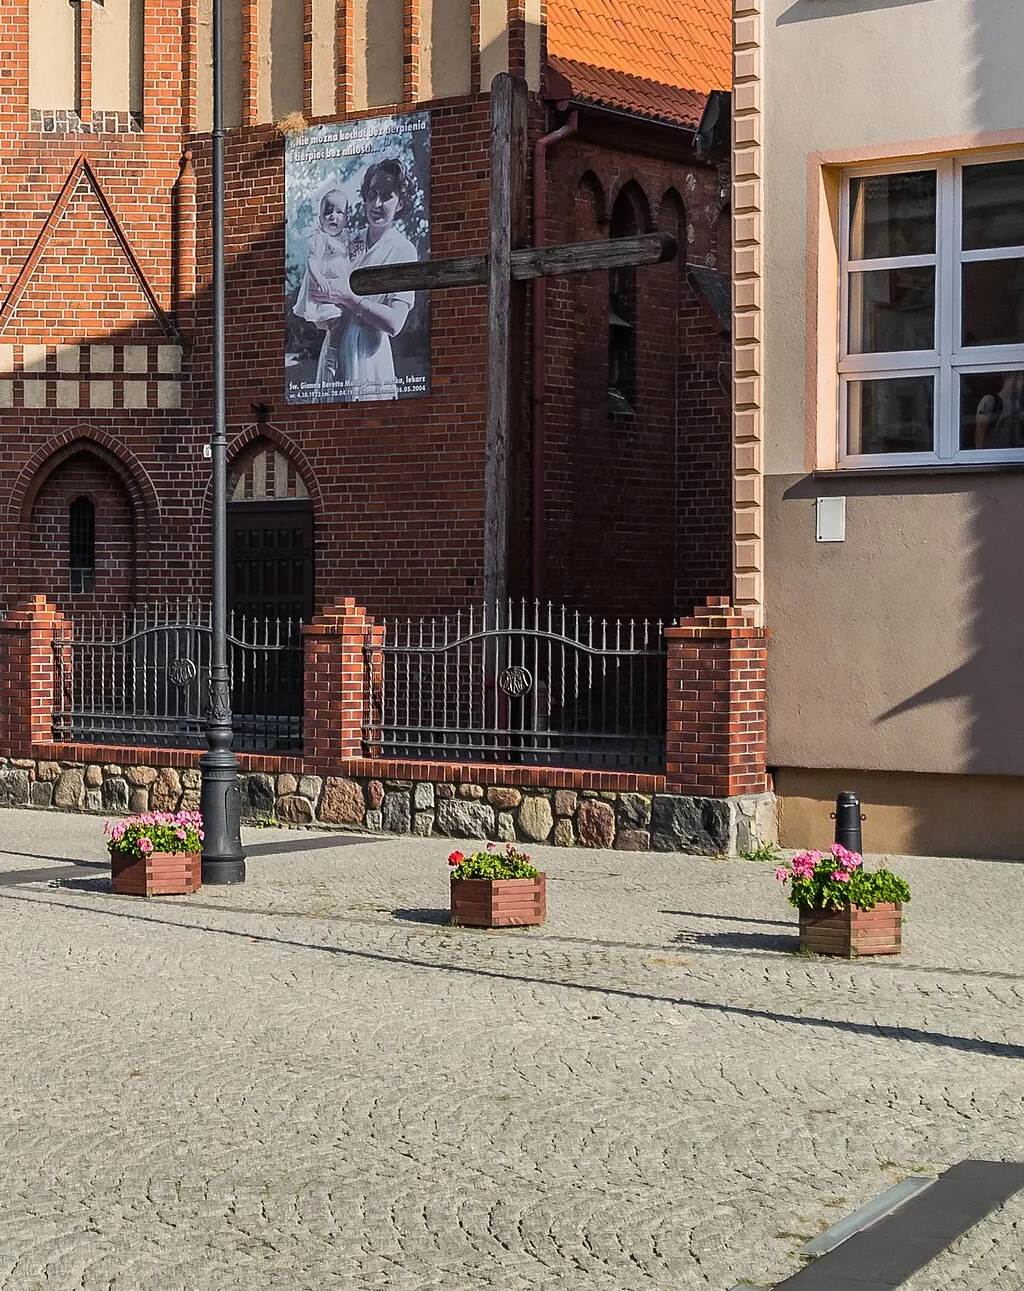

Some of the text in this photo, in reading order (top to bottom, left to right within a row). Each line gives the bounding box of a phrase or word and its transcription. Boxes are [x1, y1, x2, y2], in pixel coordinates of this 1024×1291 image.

[310, 132, 338, 145] można
[339, 127, 367, 141] kochać
[368, 125, 384, 138] bez
[385, 120, 426, 136] cierpienia
[290, 149, 294, 163] i
[295, 147, 325, 163] cierpieć
[326, 147, 341, 159] bez
[289, 381, 300, 390] Św.
[321, 379, 344, 389] Beretta
[405, 375, 426, 384] lekarz
